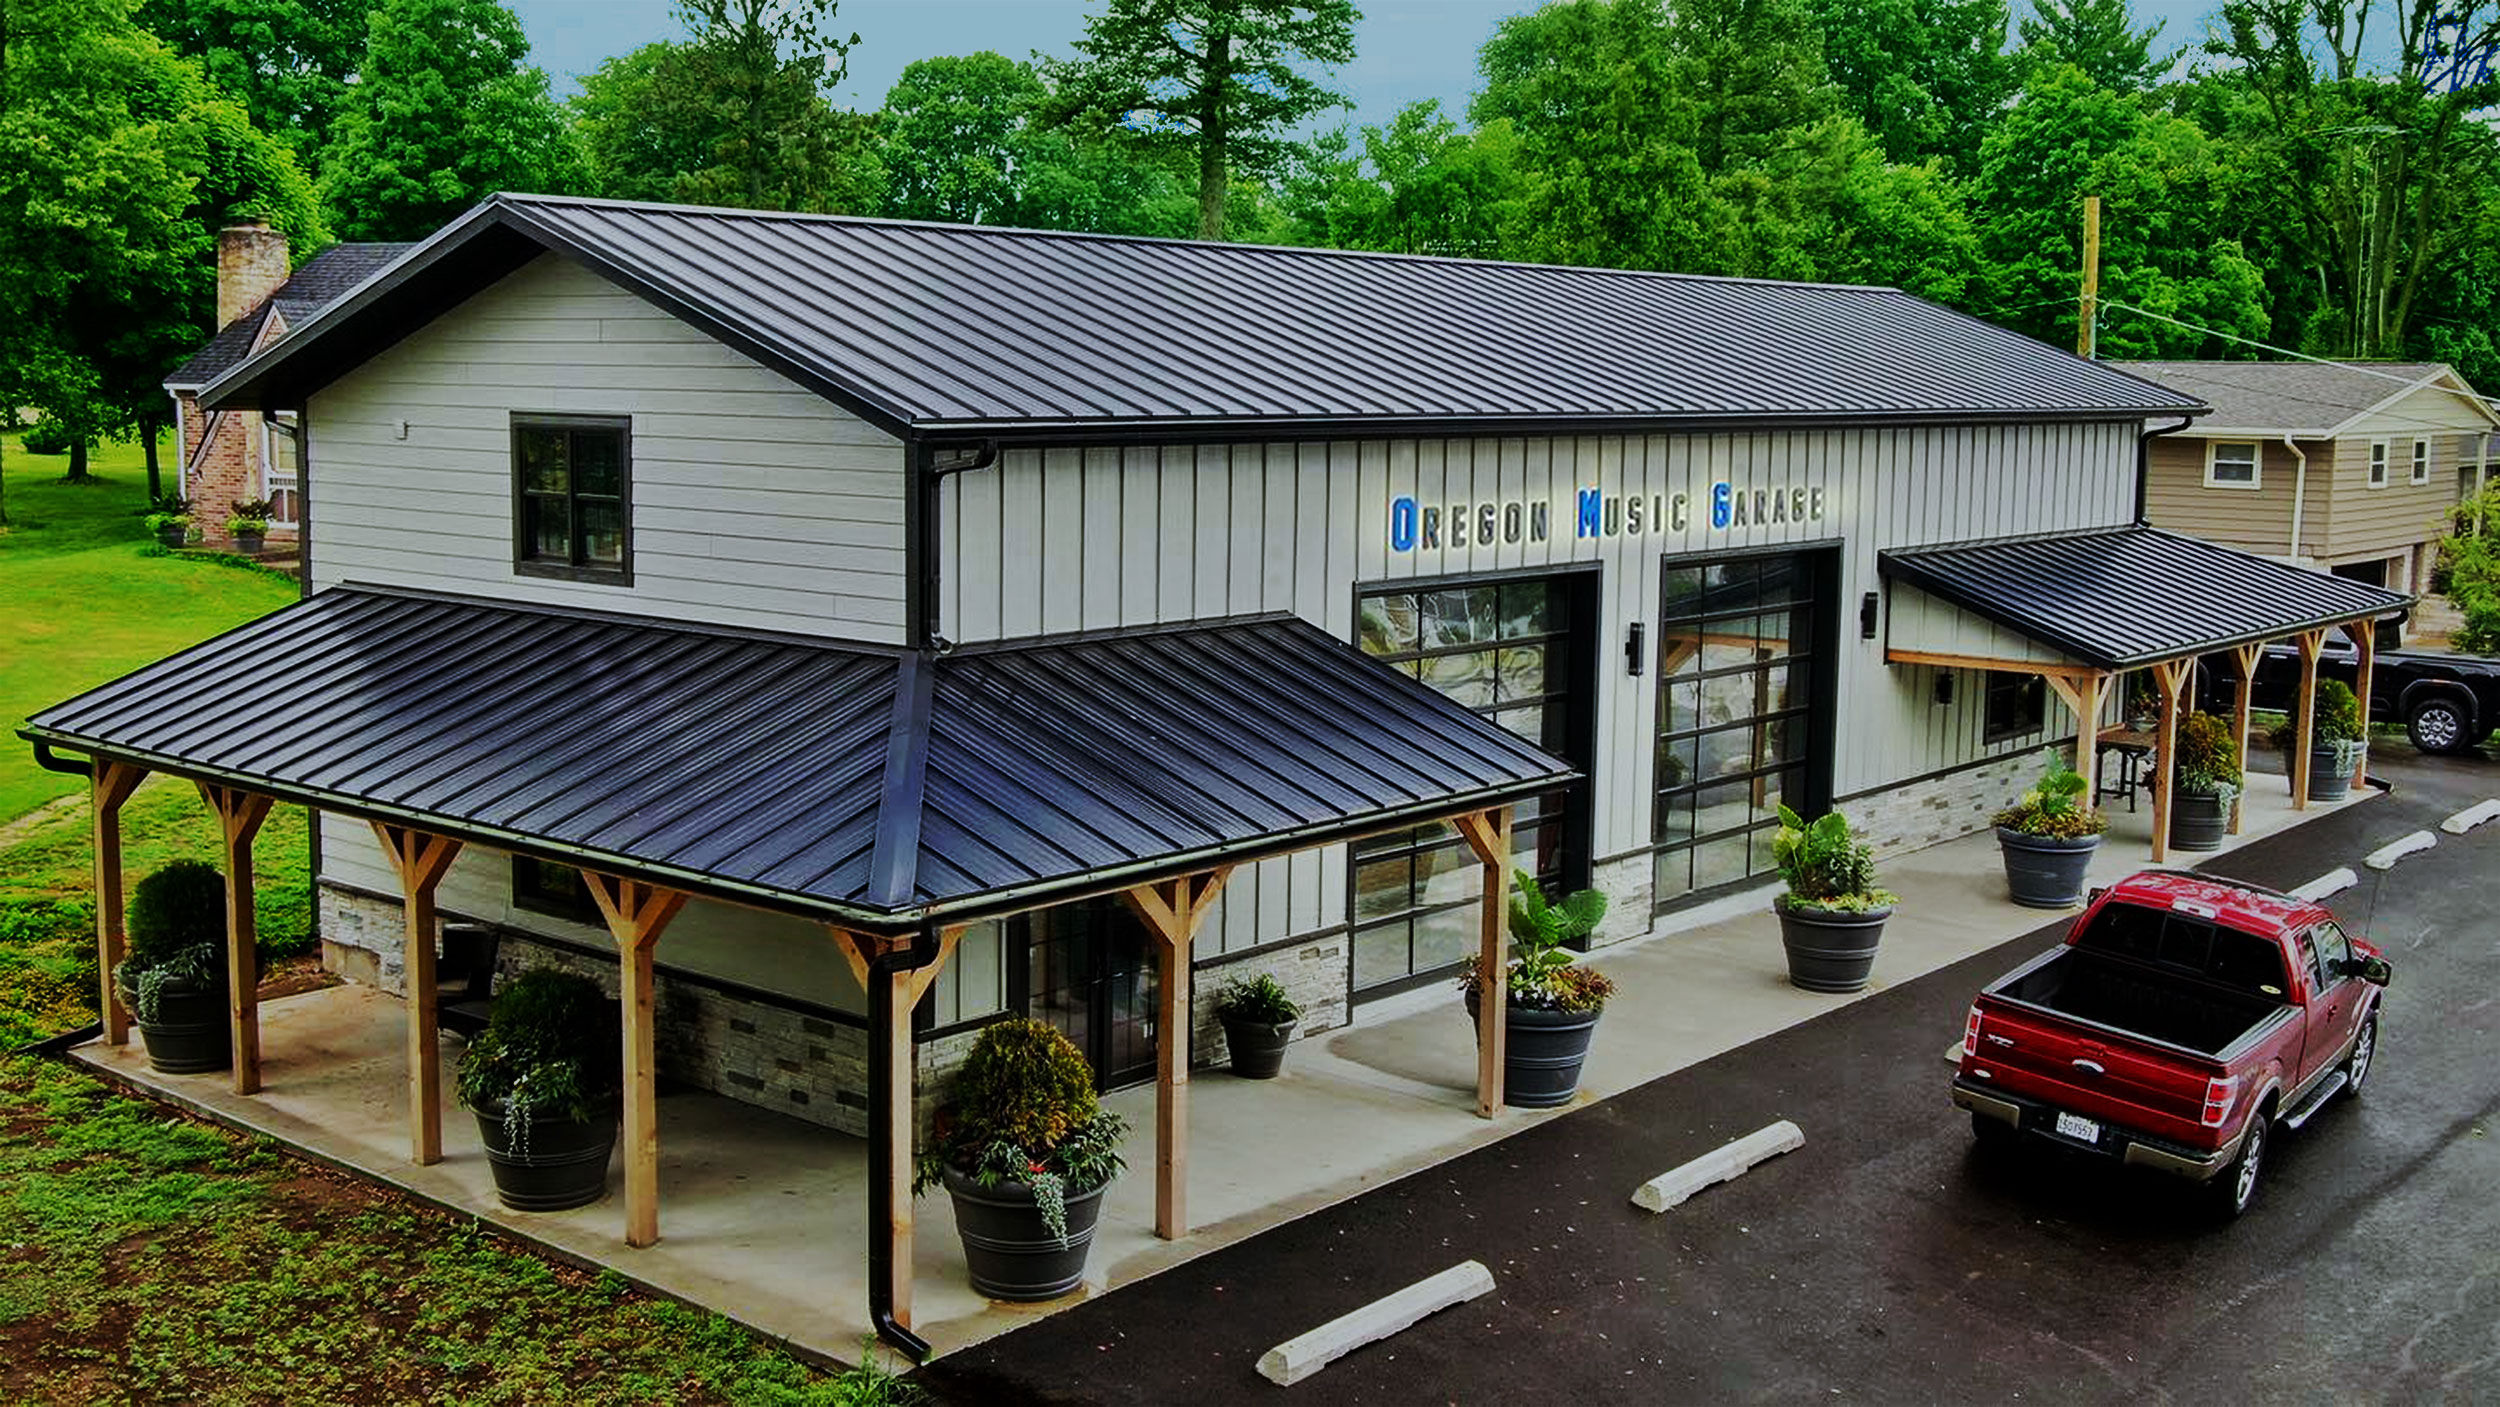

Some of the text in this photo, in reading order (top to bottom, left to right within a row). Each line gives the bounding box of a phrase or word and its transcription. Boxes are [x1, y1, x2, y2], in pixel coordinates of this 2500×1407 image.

[1391, 482, 1823, 551] OREGON MUSIC GARAGE
